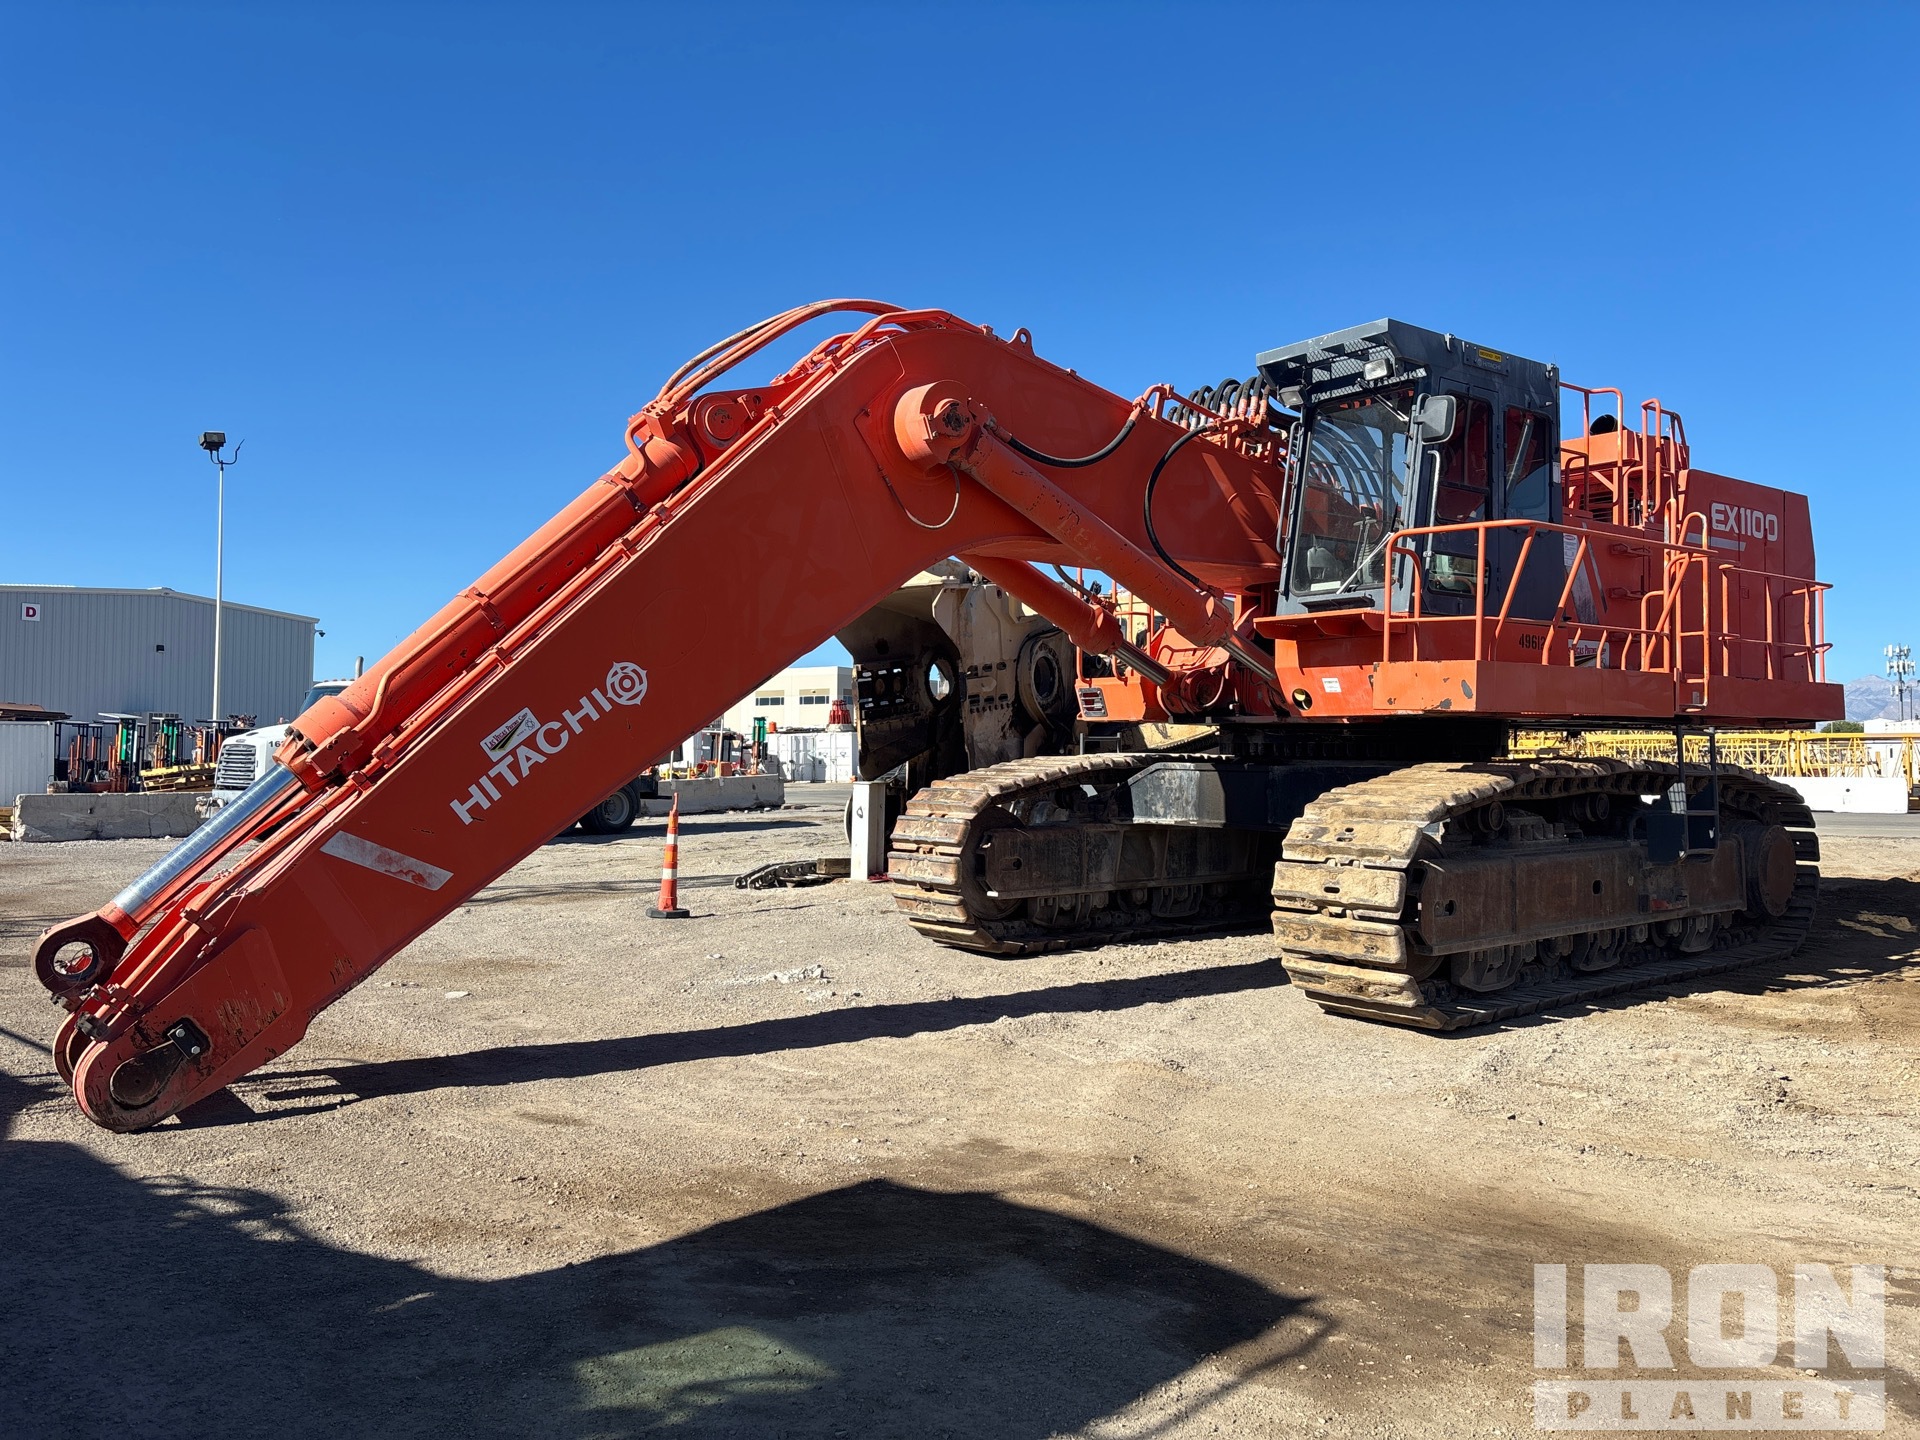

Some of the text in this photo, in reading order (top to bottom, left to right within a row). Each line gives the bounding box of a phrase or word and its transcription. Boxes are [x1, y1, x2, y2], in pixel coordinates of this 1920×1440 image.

[1711, 502, 1778, 542] EX1100
[26, 606, 36, 618] D
[1519, 633, 1552, 652] 49612
[450, 688, 613, 825] HITACHI
